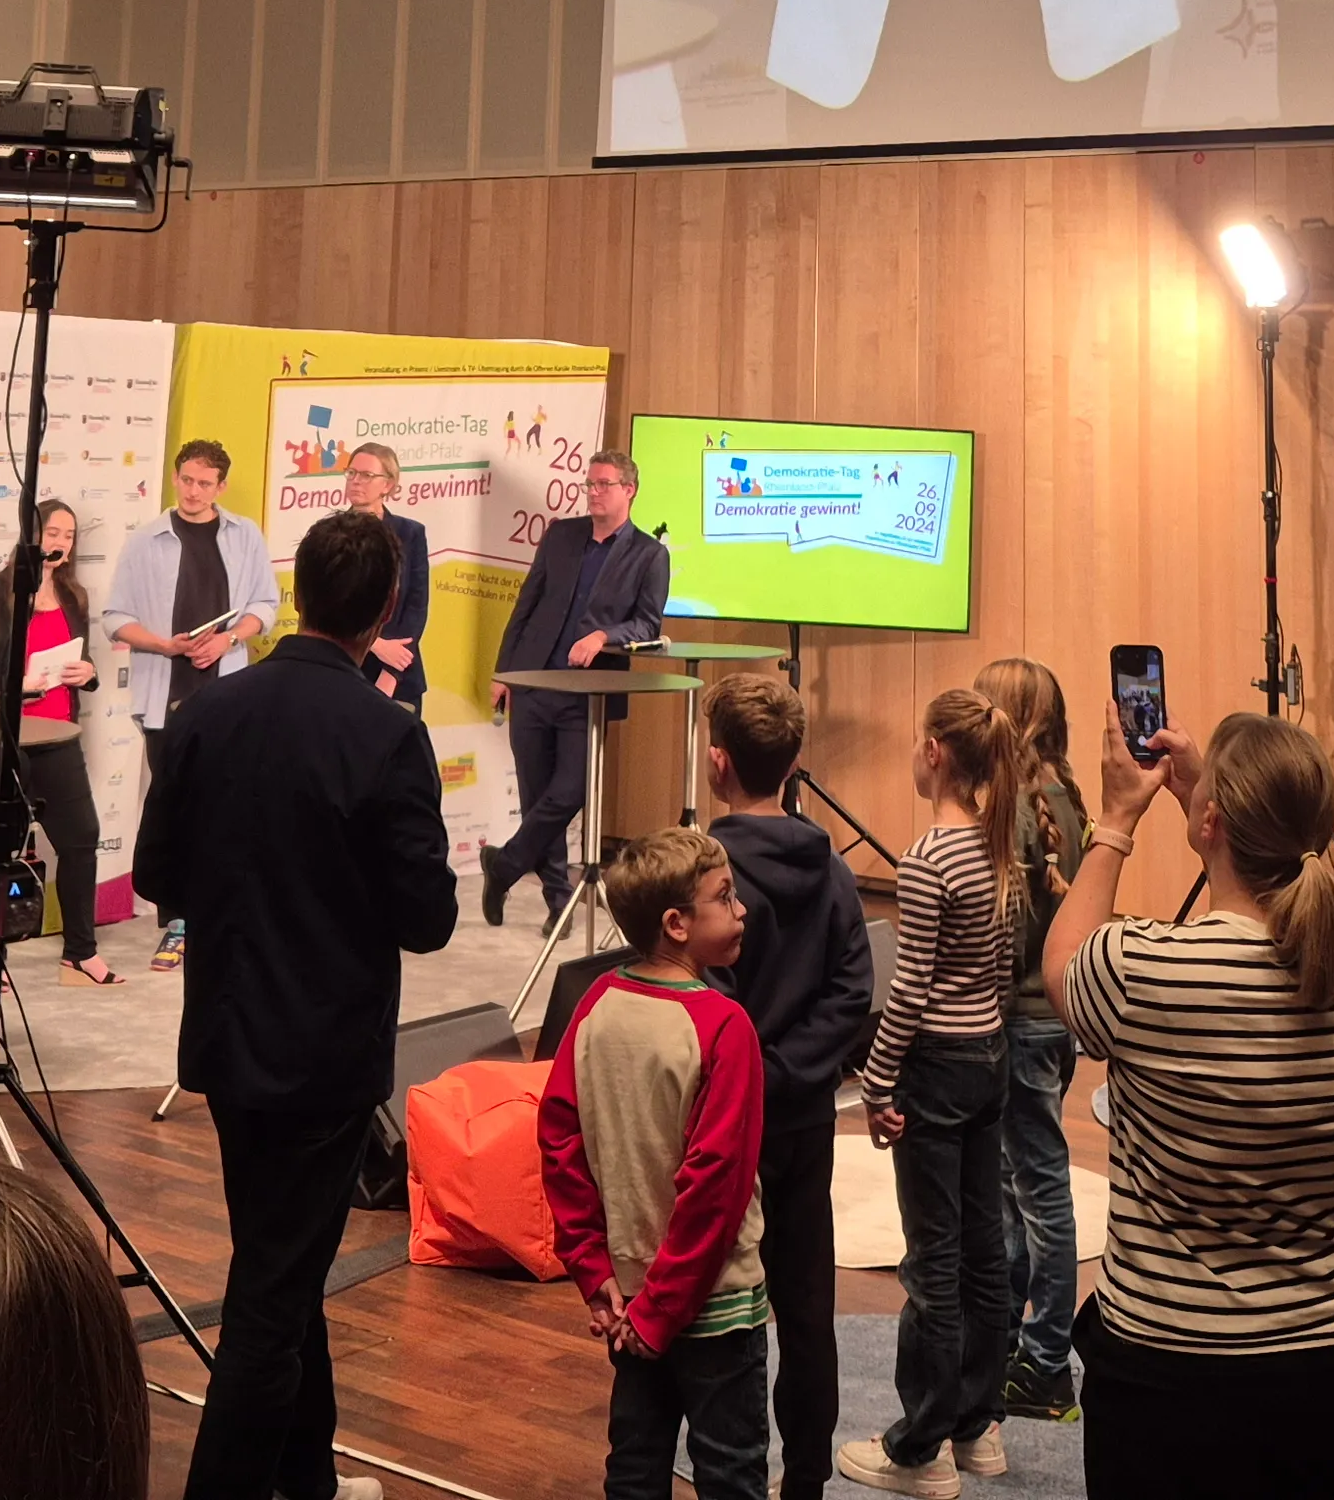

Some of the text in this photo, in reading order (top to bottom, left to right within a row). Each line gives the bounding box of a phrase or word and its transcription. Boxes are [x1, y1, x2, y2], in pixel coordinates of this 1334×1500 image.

[356, 415, 488, 437] Demokratie-Tag
[549, 437, 586, 474] 26.
[764, 466, 860, 480] Demokratie-Tag
[407, 472, 492, 506] gewinnt!
[546, 480, 580, 516] 09.
[917, 482, 940, 501] 26.
[715, 501, 861, 518] Demokratie gewinnt!
[915, 501, 937, 519] 09.
[508, 509, 546, 547] 20
[894, 514, 935, 534] 2024
